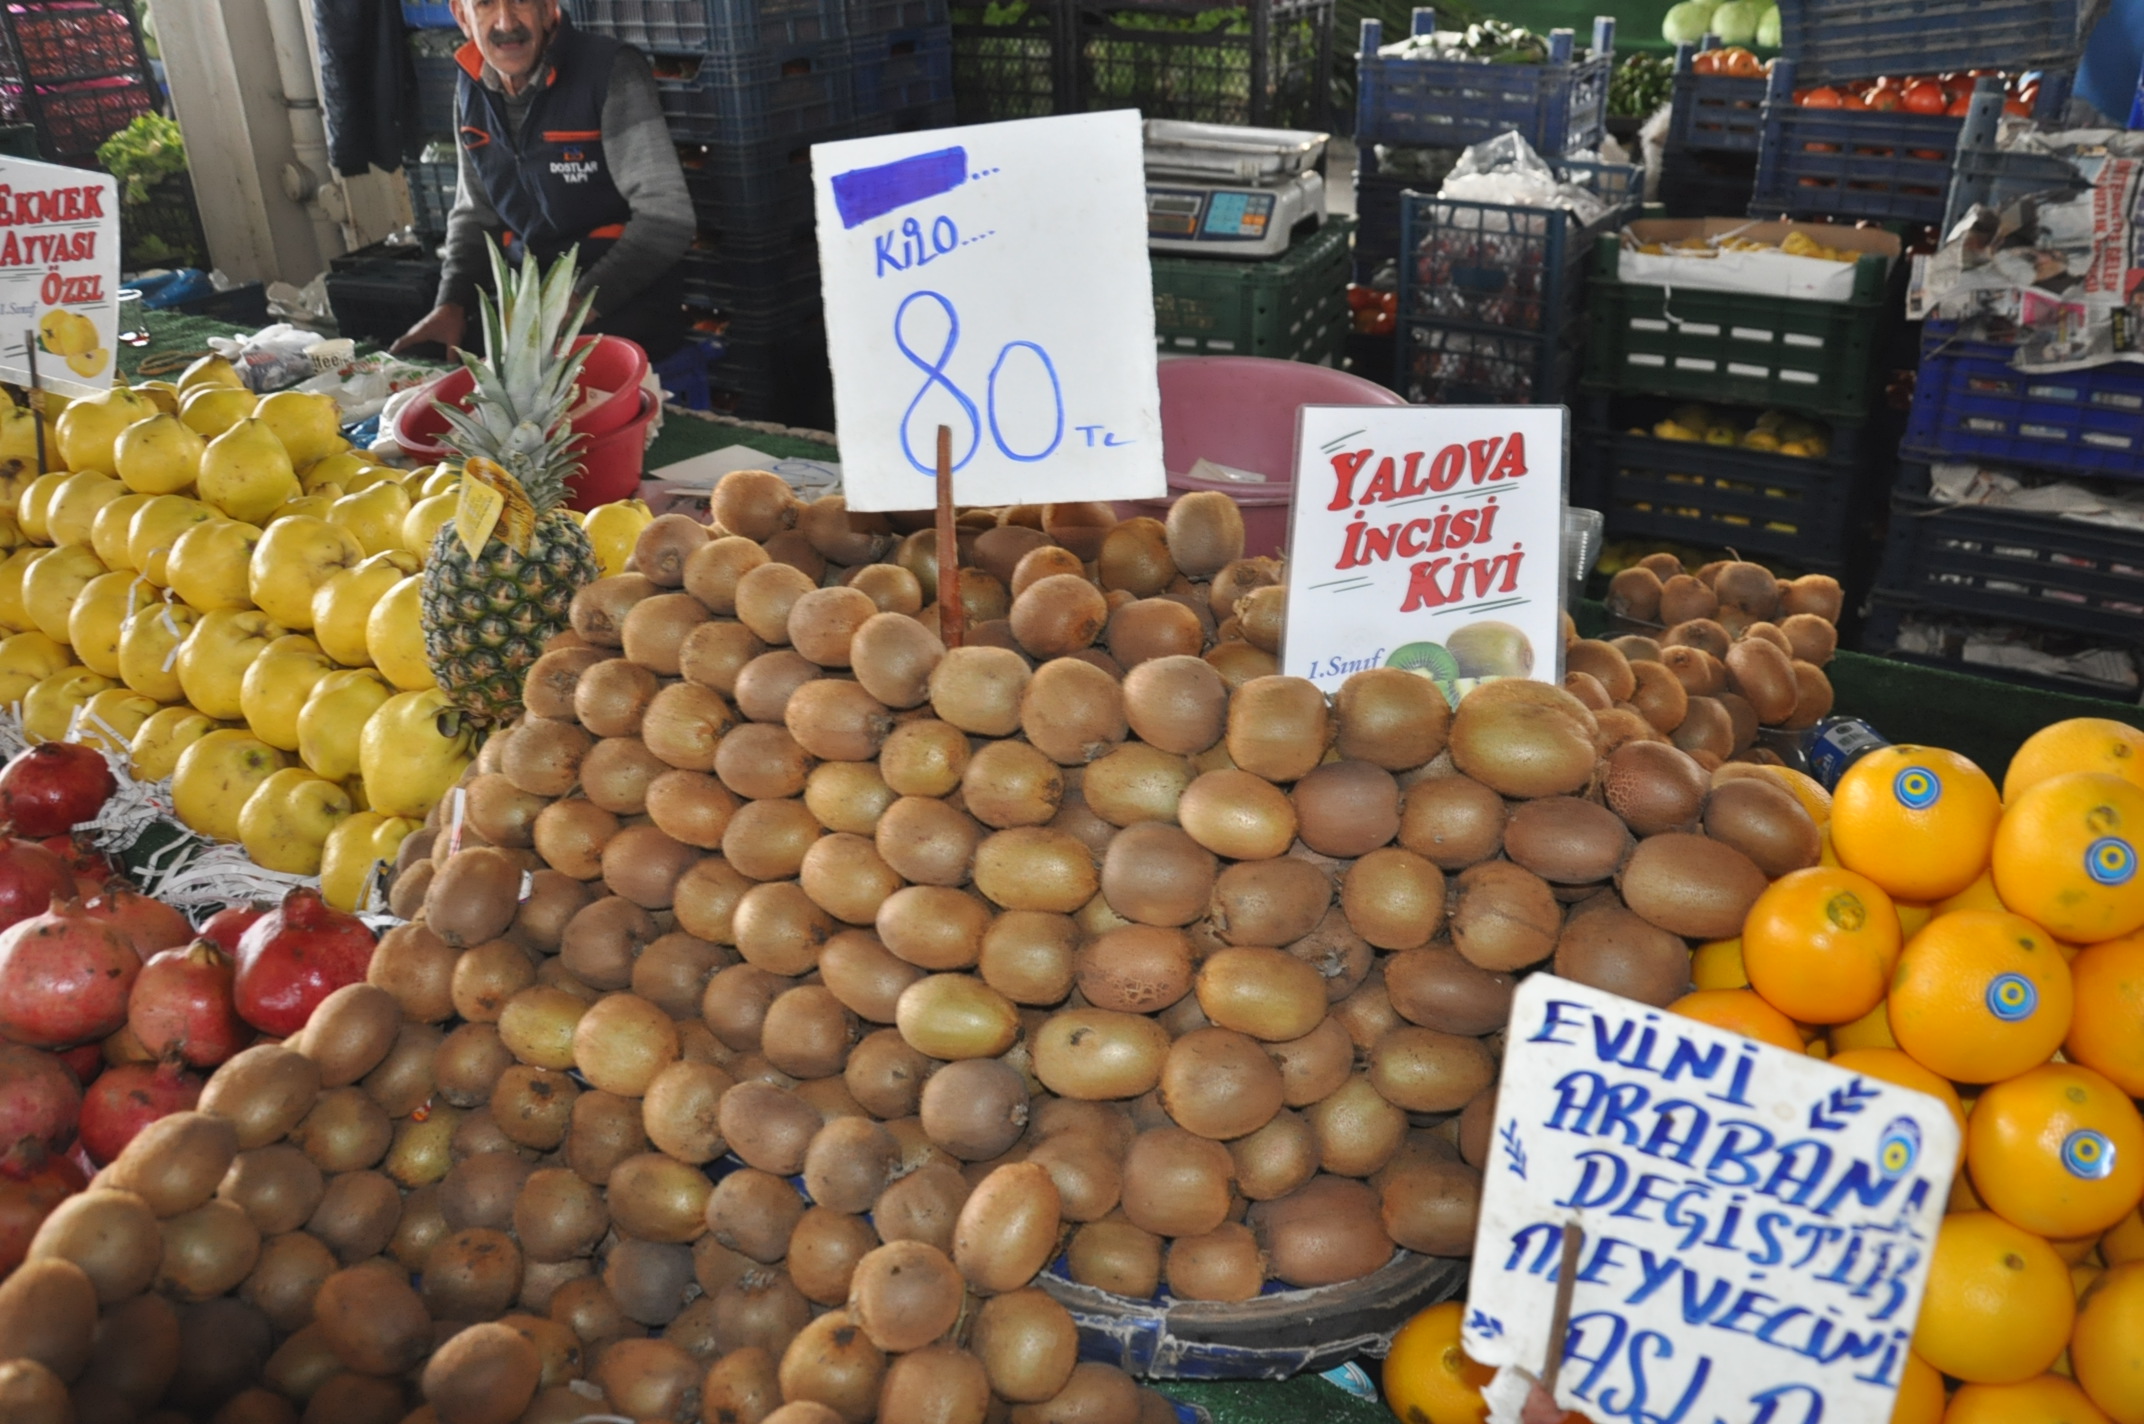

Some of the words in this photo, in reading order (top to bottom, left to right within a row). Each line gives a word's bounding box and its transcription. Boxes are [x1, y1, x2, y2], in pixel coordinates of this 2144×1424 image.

[0, 231, 97, 267] AYVASI
[41, 264, 104, 305] ÖZEL
[894, 290, 1065, 477] 80
[1327, 431, 1528, 511] YALOVA
[1334, 495, 1500, 570] İNCİSİ
[1399, 541, 1525, 613] KİVİ
[1526, 1000, 1761, 1109] EVİNİ
